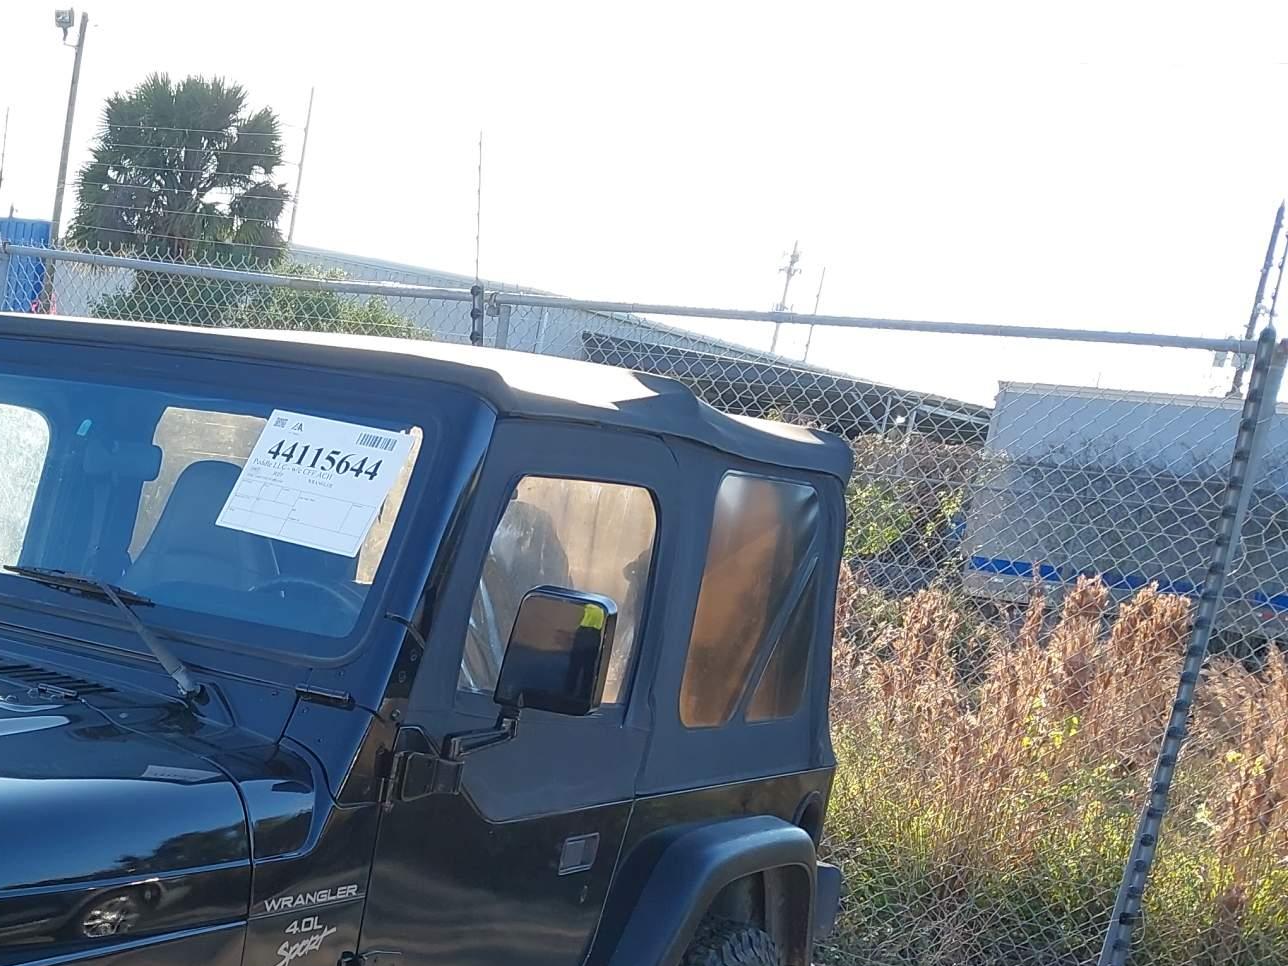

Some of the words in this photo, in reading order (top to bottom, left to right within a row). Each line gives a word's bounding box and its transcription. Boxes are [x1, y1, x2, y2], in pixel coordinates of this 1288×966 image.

[267, 438, 384, 481] 44115644
[263, 884, 358, 913] WRANGLER
[284, 915, 324, 935] 4.0L
